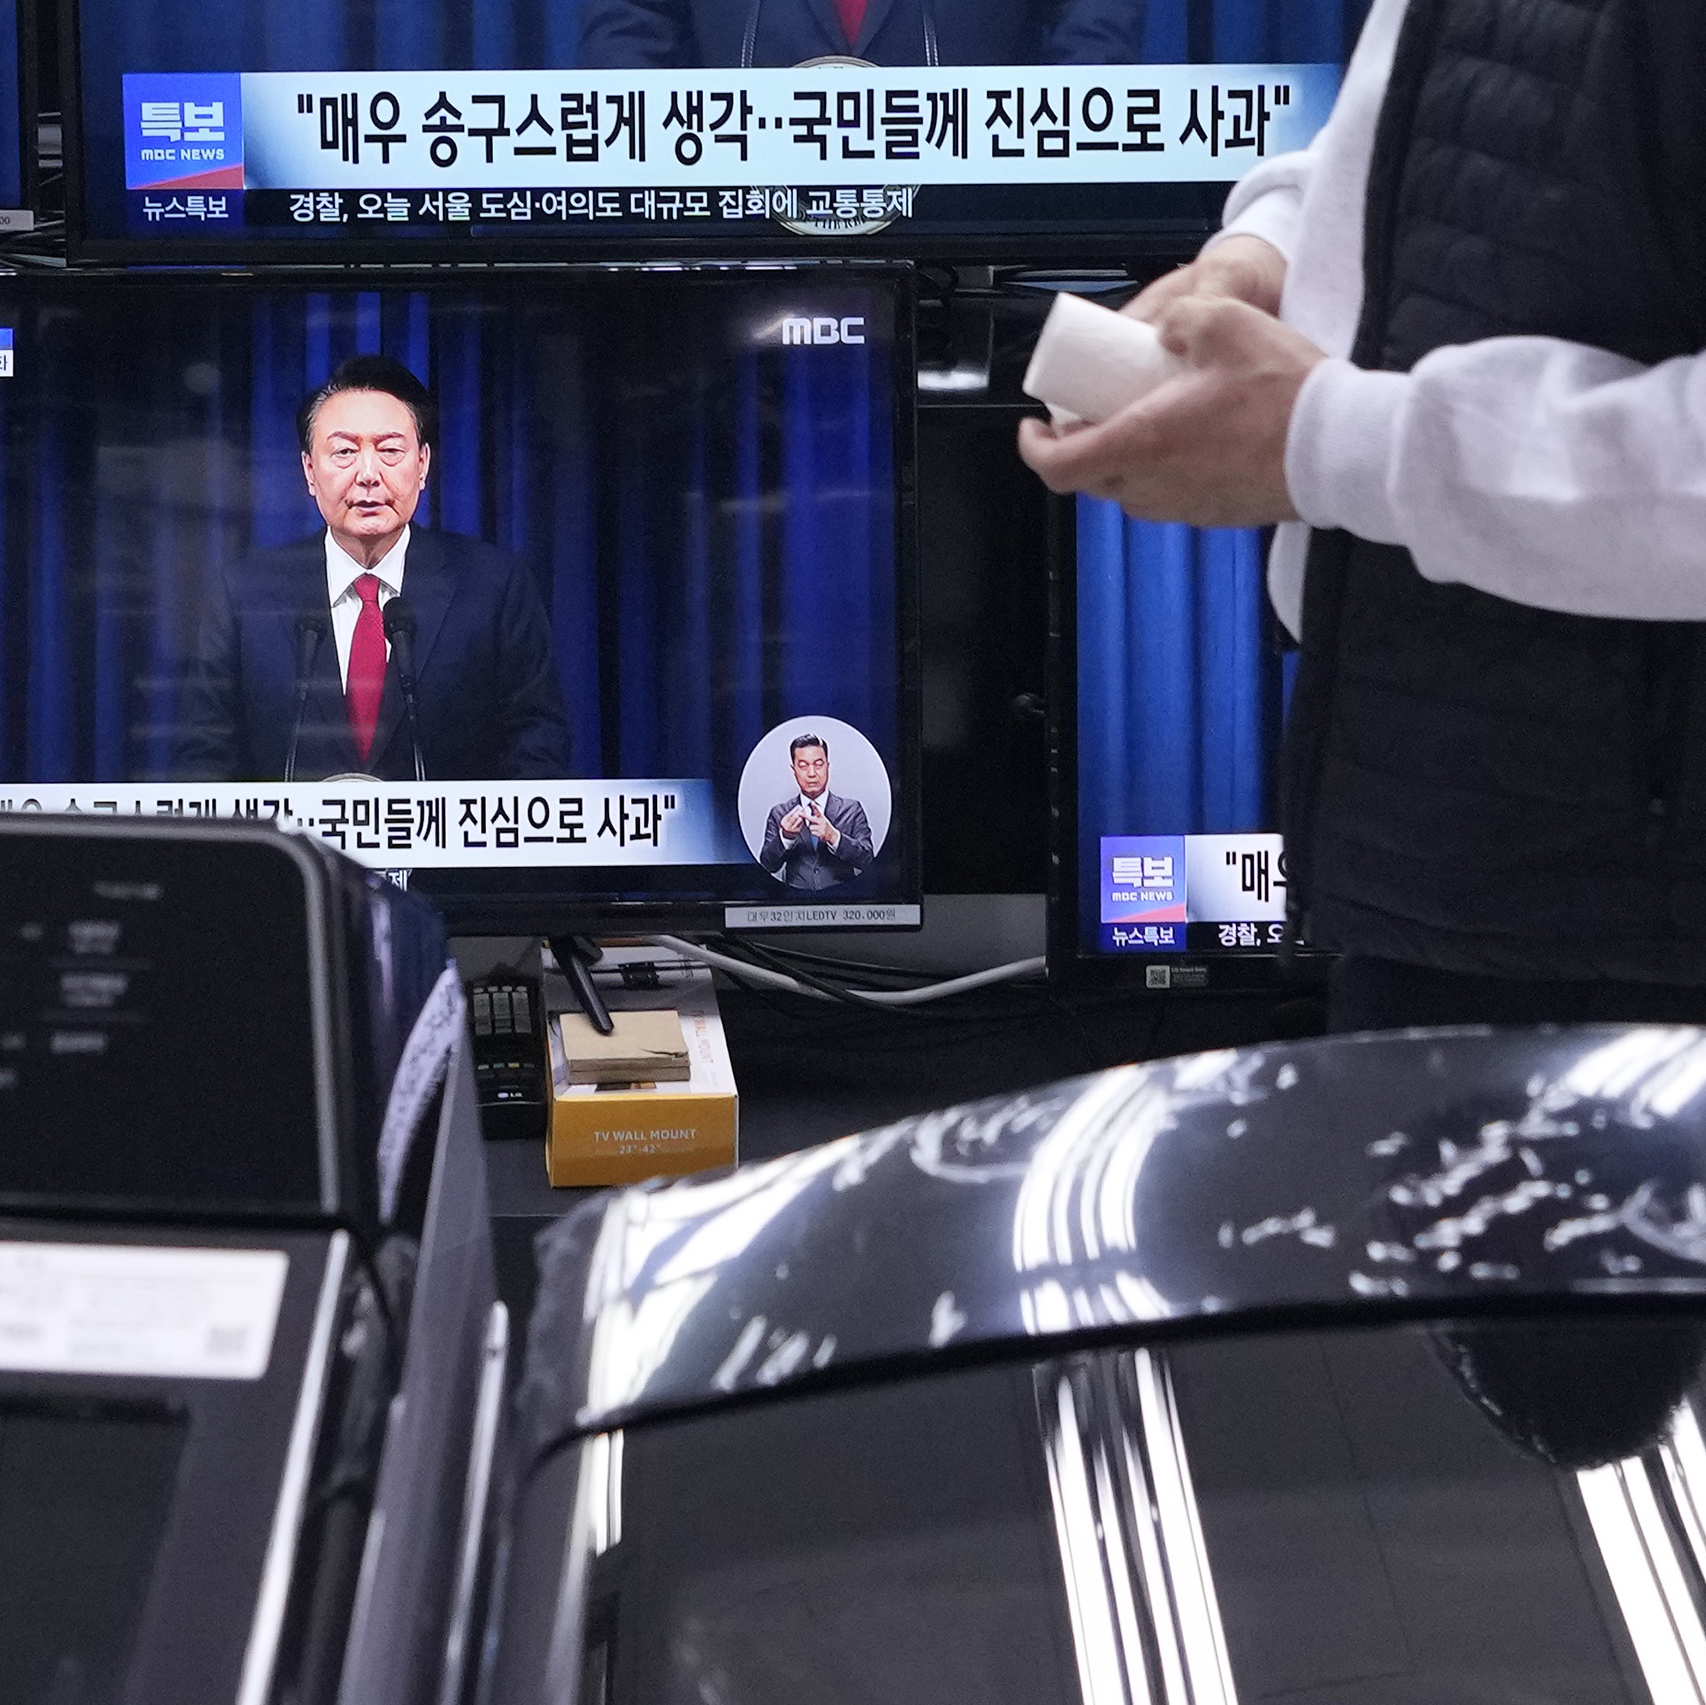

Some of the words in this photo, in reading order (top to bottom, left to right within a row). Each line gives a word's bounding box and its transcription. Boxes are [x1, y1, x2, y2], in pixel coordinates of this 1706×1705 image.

[141, 101, 224, 142] 특보
[297, 90, 406, 164] "매우
[421, 90, 647, 167] 송구스럽게
[985, 86, 1165, 159] 진심으로
[1179, 84, 1290, 157] 사과"
[141, 149, 176, 161] MBC
[180, 149, 224, 161] NEWS
[142, 196, 228, 221] 뉴스특보
[289, 192, 349, 223] 경찰,
[357, 192, 410, 221] 오늘
[419, 192, 471, 221] 서울
[630, 191, 710, 220] 대규모
[719, 189, 798, 219] 집회에
[806, 187, 914, 218] 교통통제
[781, 318, 865, 344] MBC
[458, 795, 587, 847] 진심으로
[597, 794, 676, 847] 사과"
[1112, 856, 1174, 887] 특보
[1112, 892, 1138, 901] MBC
[1141, 891, 1173, 901] NEWS
[1112, 926, 1175, 946] 뉴스특보
[1219, 924, 1261, 946] 경찰,
[595, 1132, 610, 1141] TV
[612, 1131, 645, 1141] WALL
[650, 1129, 696, 1140] MOUNT
